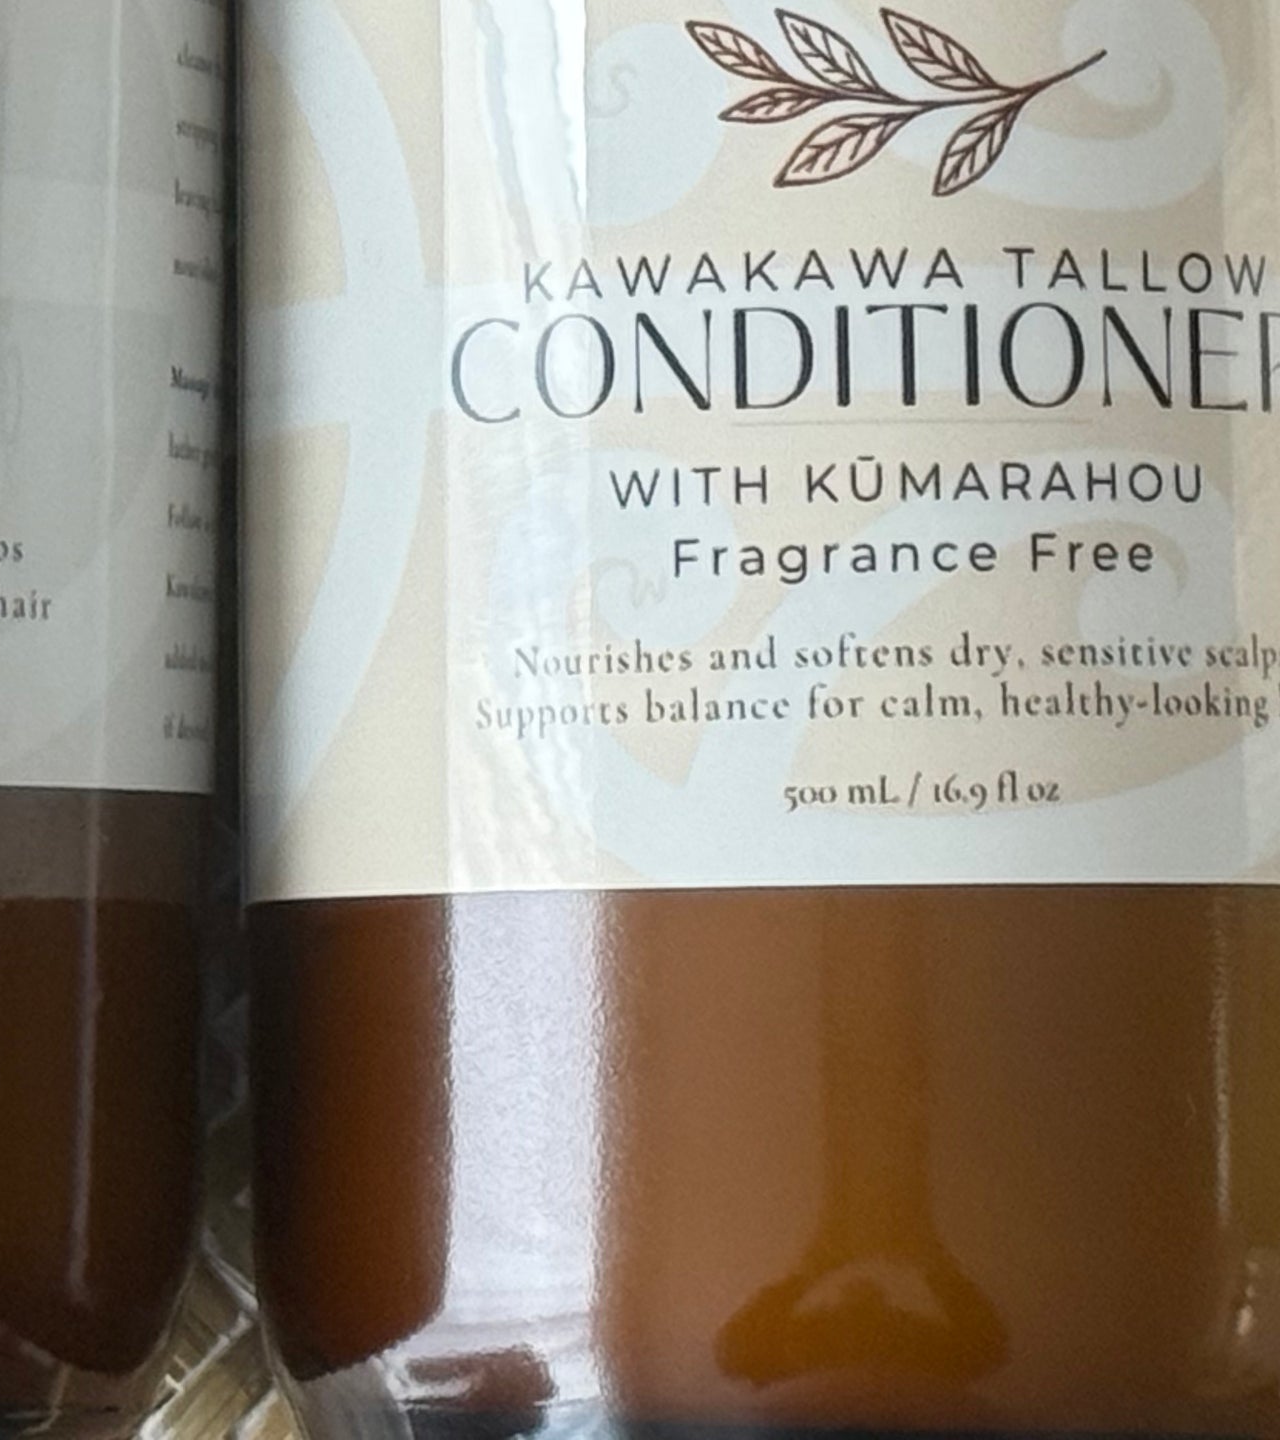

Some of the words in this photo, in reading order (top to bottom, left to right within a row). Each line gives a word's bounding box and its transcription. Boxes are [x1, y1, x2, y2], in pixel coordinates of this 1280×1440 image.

[524, 246, 965, 302] KAWAKAWA
[1001, 246, 1266, 297] TALLOW
[608, 464, 768, 510] WITH
[805, 454, 1202, 504] KŪMARAHOU
[673, 537, 998, 586] Fragrance
[1030, 531, 1154, 574] Free
[514, 639, 693, 679] Nourishes
[709, 634, 778, 671] and
[794, 634, 934, 669] softens
[949, 631, 1025, 679] dry,
[1041, 635, 1193, 668] sensitive
[475, 697, 629, 741] Supports
[645, 689, 791, 724] balance
[808, 682, 865, 720] for
[879, 681, 983, 722] calm,
[999, 679, 1270, 729] healthy-looking
[783, 785, 839, 814] 500
[847, 774, 901, 805] mL
[906, 770, 923, 810] /
[933, 773, 989, 812] 16.9
[997, 769, 1019, 803] fl
[1026, 781, 1061, 803] oz
